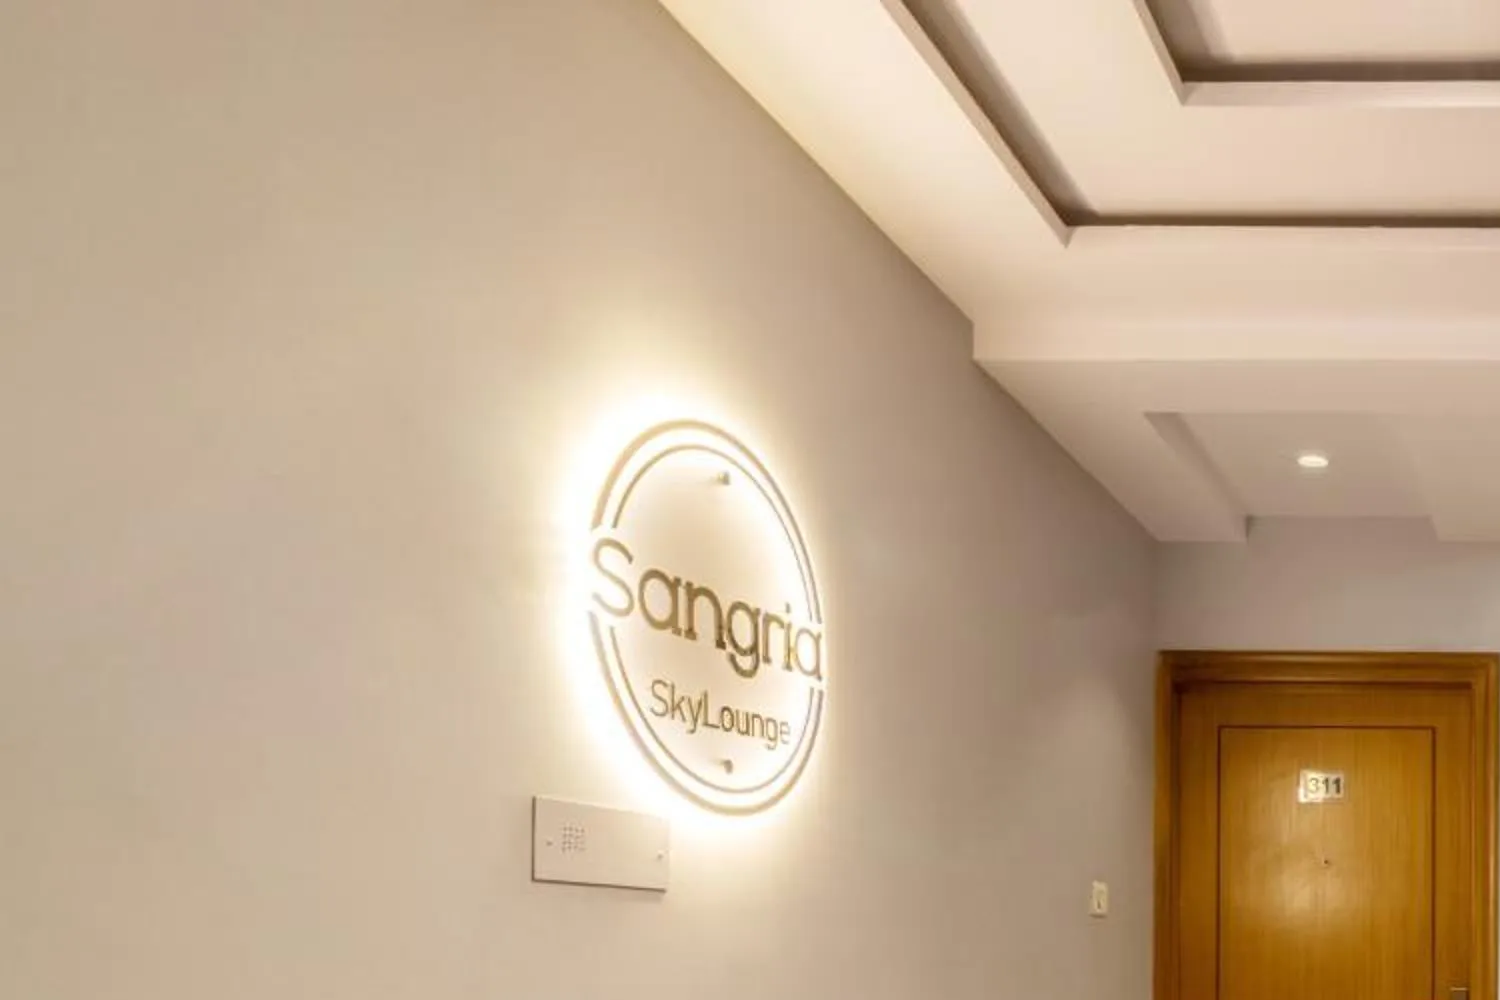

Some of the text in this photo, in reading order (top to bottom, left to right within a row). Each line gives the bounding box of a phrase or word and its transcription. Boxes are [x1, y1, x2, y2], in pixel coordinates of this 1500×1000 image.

[591, 537, 824, 682] Sangria
[649, 678, 791, 751] SkyLounge
[1309, 777, 1341, 795] 311
